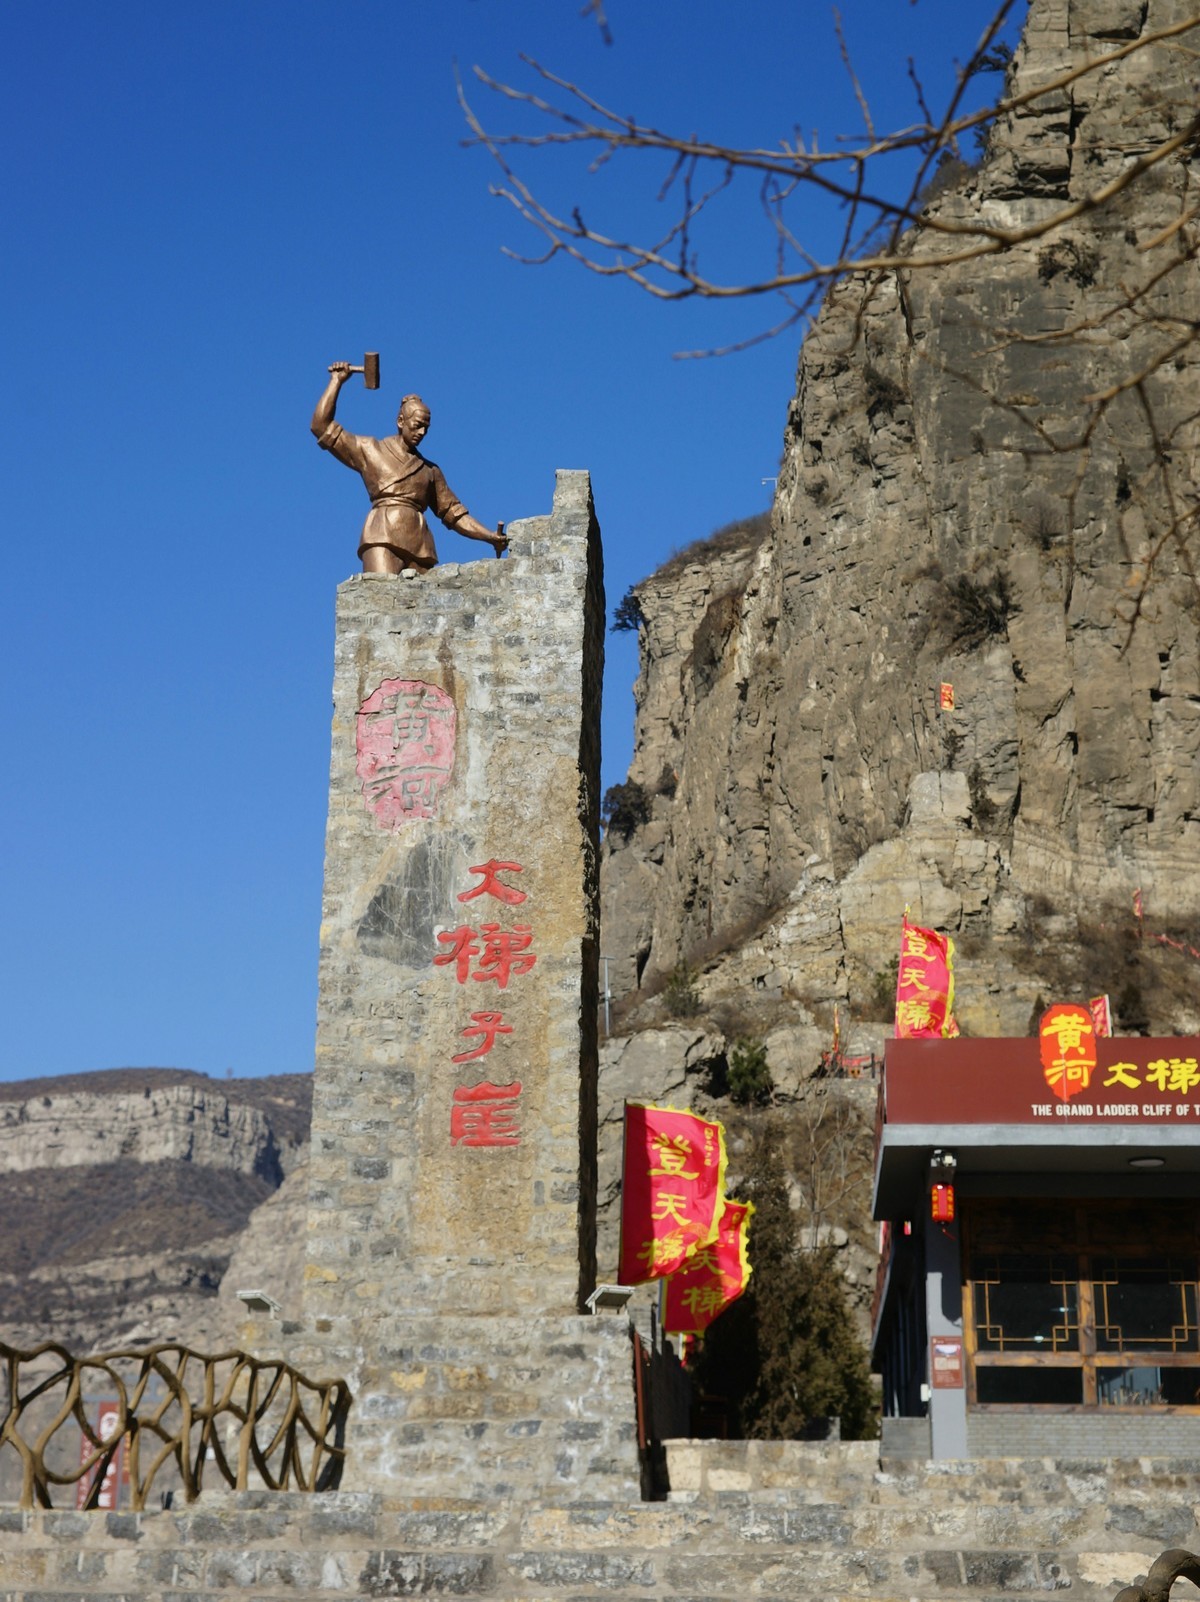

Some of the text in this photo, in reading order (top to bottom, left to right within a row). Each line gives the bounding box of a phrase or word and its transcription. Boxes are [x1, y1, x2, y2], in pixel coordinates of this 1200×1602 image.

[432, 858, 537, 1147] 大梯子崖
[897, 929, 937, 1030] 登天梯
[1042, 1013, 1097, 1088] 黄河
[1102, 1058, 1200, 1095] 大梯
[1031, 1104, 1052, 1116] THE
[1055, 1104, 1093, 1116] GRAND
[1096, 1104, 1139, 1116] LADDER
[1142, 1104, 1172, 1116] CLIFF
[1175, 1104, 1191, 1116] OF
[637, 1132, 700, 1265] 登天梯
